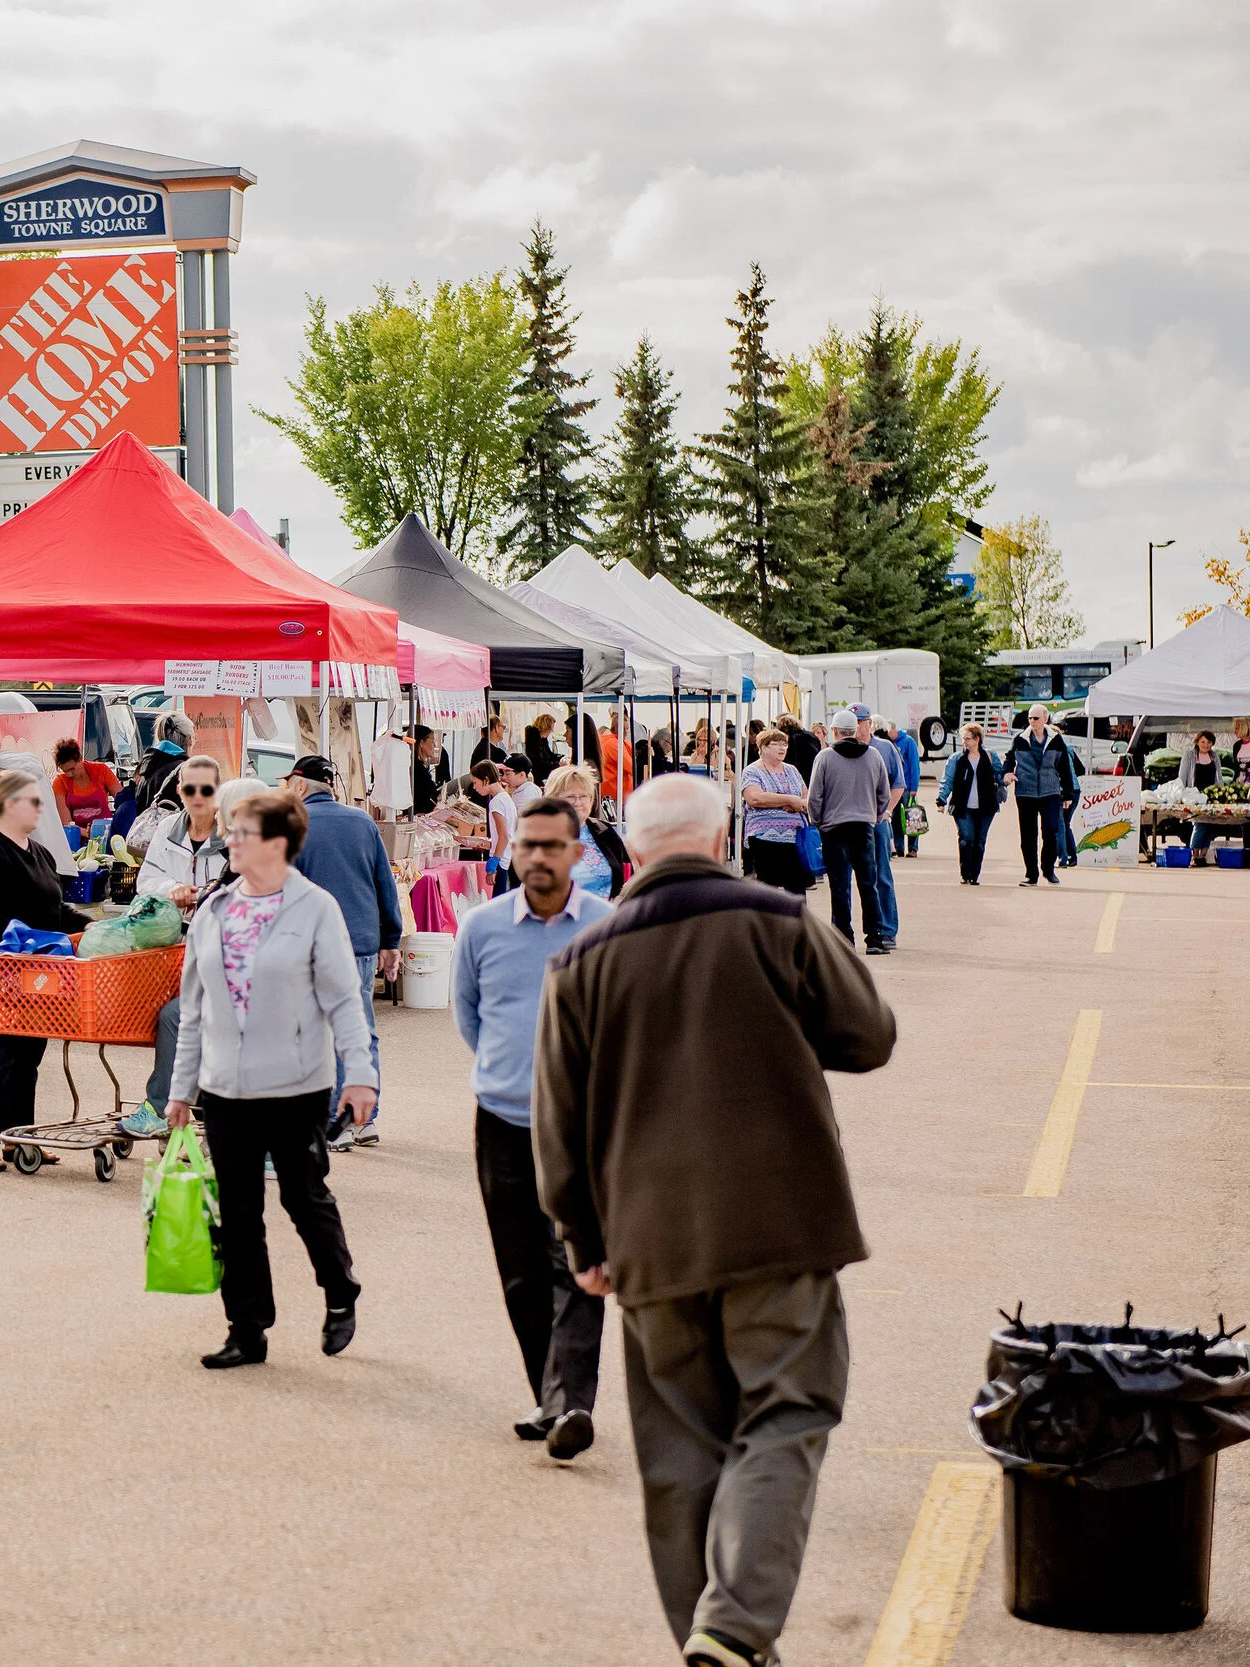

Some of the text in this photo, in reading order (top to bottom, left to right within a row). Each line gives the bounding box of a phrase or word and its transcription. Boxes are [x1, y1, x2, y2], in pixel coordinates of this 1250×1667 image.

[3, 193, 157, 223] SHERWOOD
[10, 216, 148, 238] TOWNE SQUARE
[61, 325, 174, 449] DEPOT
[25, 465, 80, 480] EVERY
[1082, 780, 1125, 810] Sweet
[1111, 800, 1135, 817] Corn
